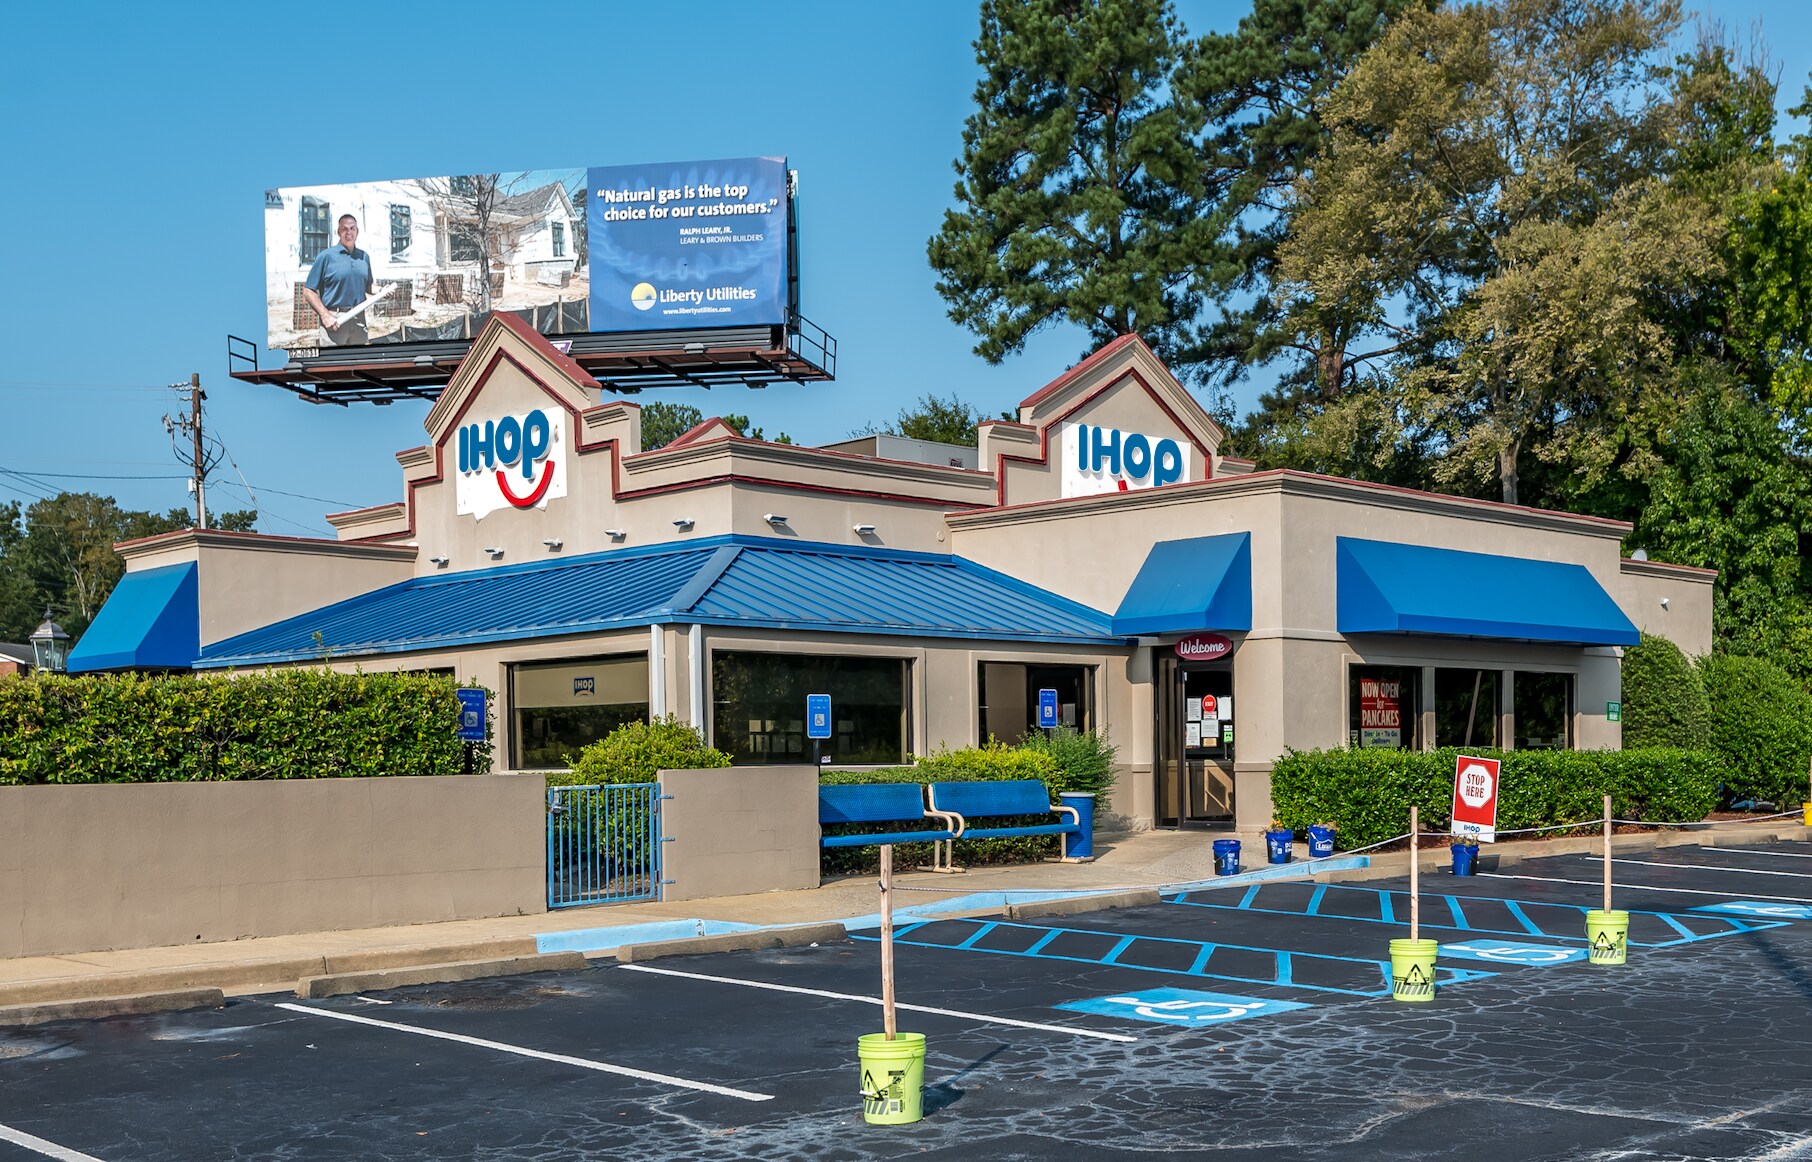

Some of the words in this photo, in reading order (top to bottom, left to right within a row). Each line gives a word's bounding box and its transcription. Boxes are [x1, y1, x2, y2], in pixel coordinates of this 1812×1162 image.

[658, 189, 682, 204] gas
[684, 185, 696, 199] is
[698, 184, 721, 198] the
[724, 183, 748, 200] top
[603, 206, 647, 221] choice
[649, 205, 669, 219] for
[671, 206, 695, 217] our
[680, 227, 701, 236] RALPH
[701, 226, 723, 235] LEARY,
[723, 226, 733, 234] JR.
[680, 236, 700, 244] LEARY
[706, 235, 732, 244] BROWN
[732, 233, 764, 242] BUILDERS
[660, 288, 704, 305] Liberty
[706, 286, 757, 301] Utilities
[662, 306, 732, 315] www.libertyutilities.com
[459, 409, 550, 479] IHOP
[1078, 423, 1183, 487] IHOP
[1180, 639, 1226, 655] Welcome
[575, 679, 594, 692] IHOP
[1361, 682, 1379, 698] NOW
[1380, 683, 1399, 699] OPEN
[1376, 697, 1385, 710] for
[1361, 709, 1400, 727] PANCAKES
[1466, 773, 1486, 786] STOP
[1465, 785, 1485, 799] HERE
